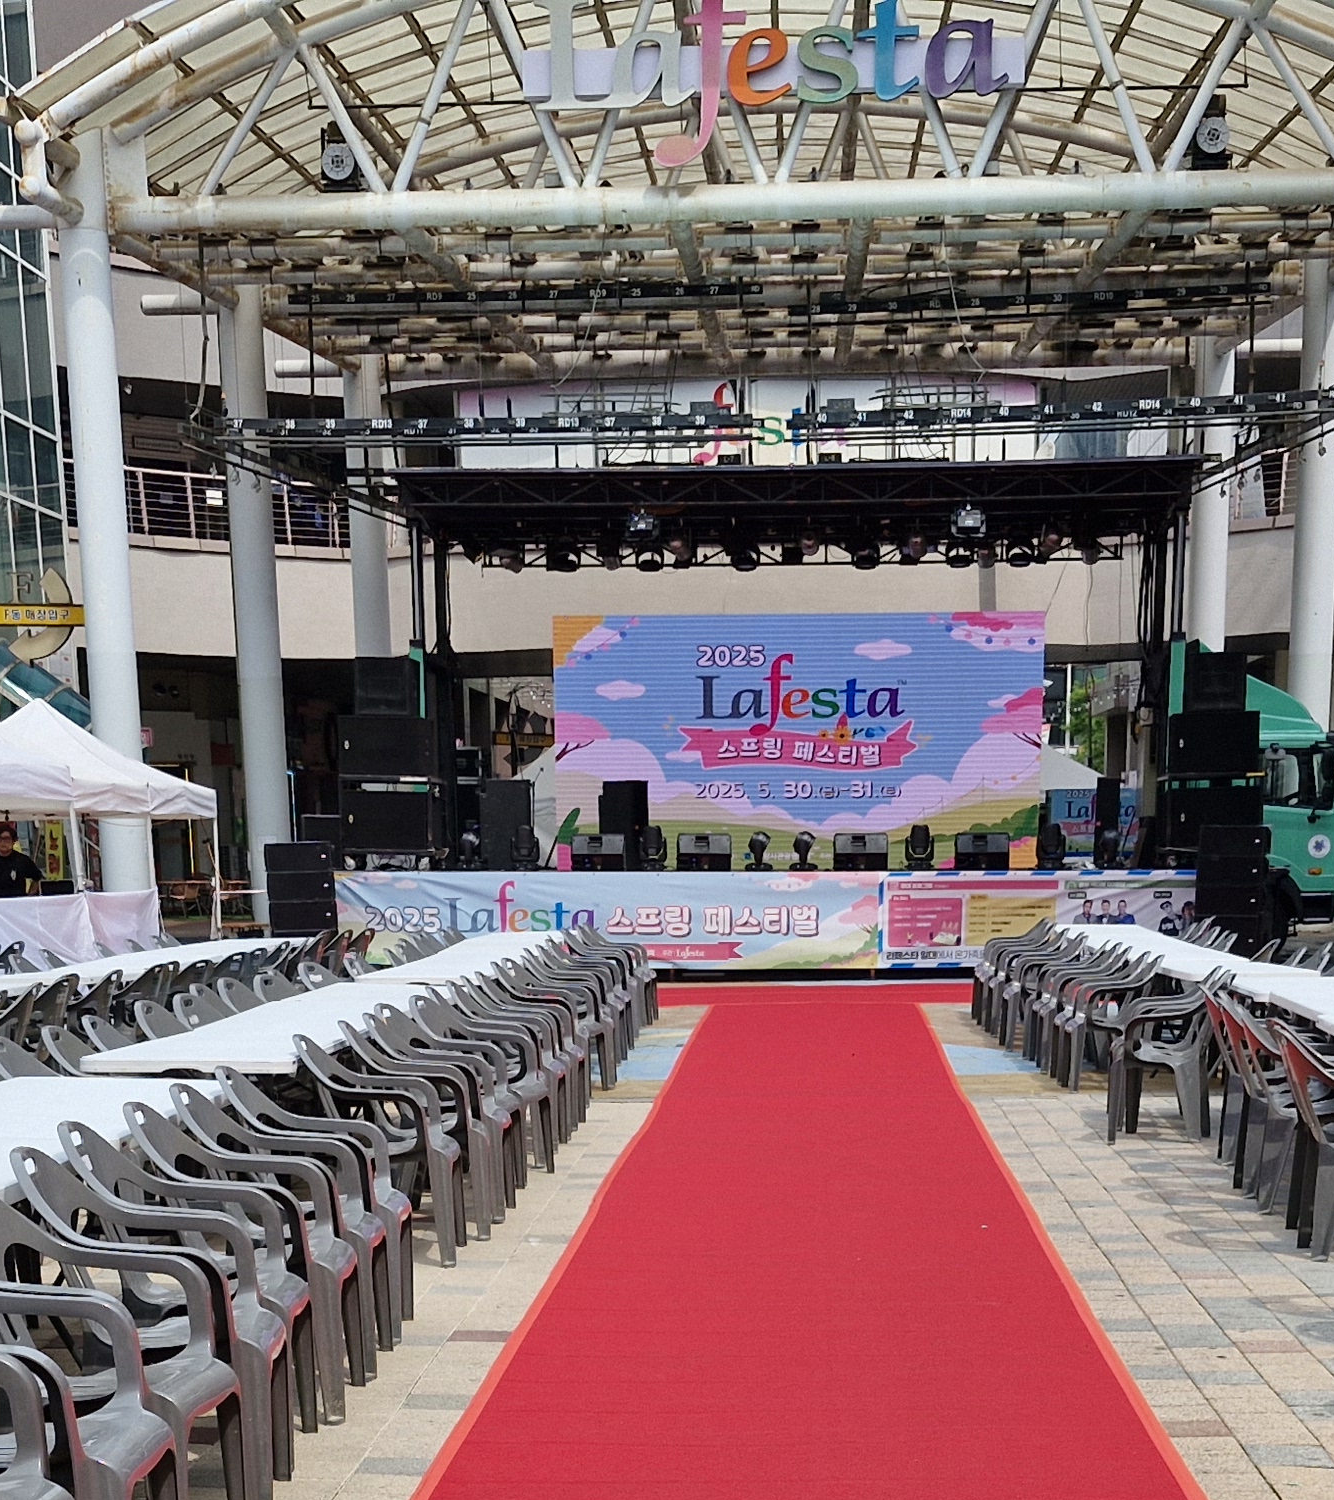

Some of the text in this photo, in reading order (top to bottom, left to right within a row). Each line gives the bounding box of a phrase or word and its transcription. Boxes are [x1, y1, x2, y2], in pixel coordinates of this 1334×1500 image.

[536, 0, 1009, 167] Lafesta
[426, 292, 443, 301] RD9
[1092, 401, 1103, 412] 42
[1139, 399, 1161, 410] RD14
[1190, 397, 1201, 407] 40
[951, 408, 972, 419] RD14
[371, 419, 393, 429] RD13
[557, 416, 579, 427] RD13
[7, 571, 34, 603] F
[696, 645, 766, 667] 2025
[695, 653, 905, 737] Lafesta
[717, 736, 882, 767] 스프링 페스티벌
[695, 782, 776, 800] 2025. 5.
[1066, 790, 1090, 798] 2025
[364, 880, 820, 937] 2025 Lafesta 스프링 페스티벌
